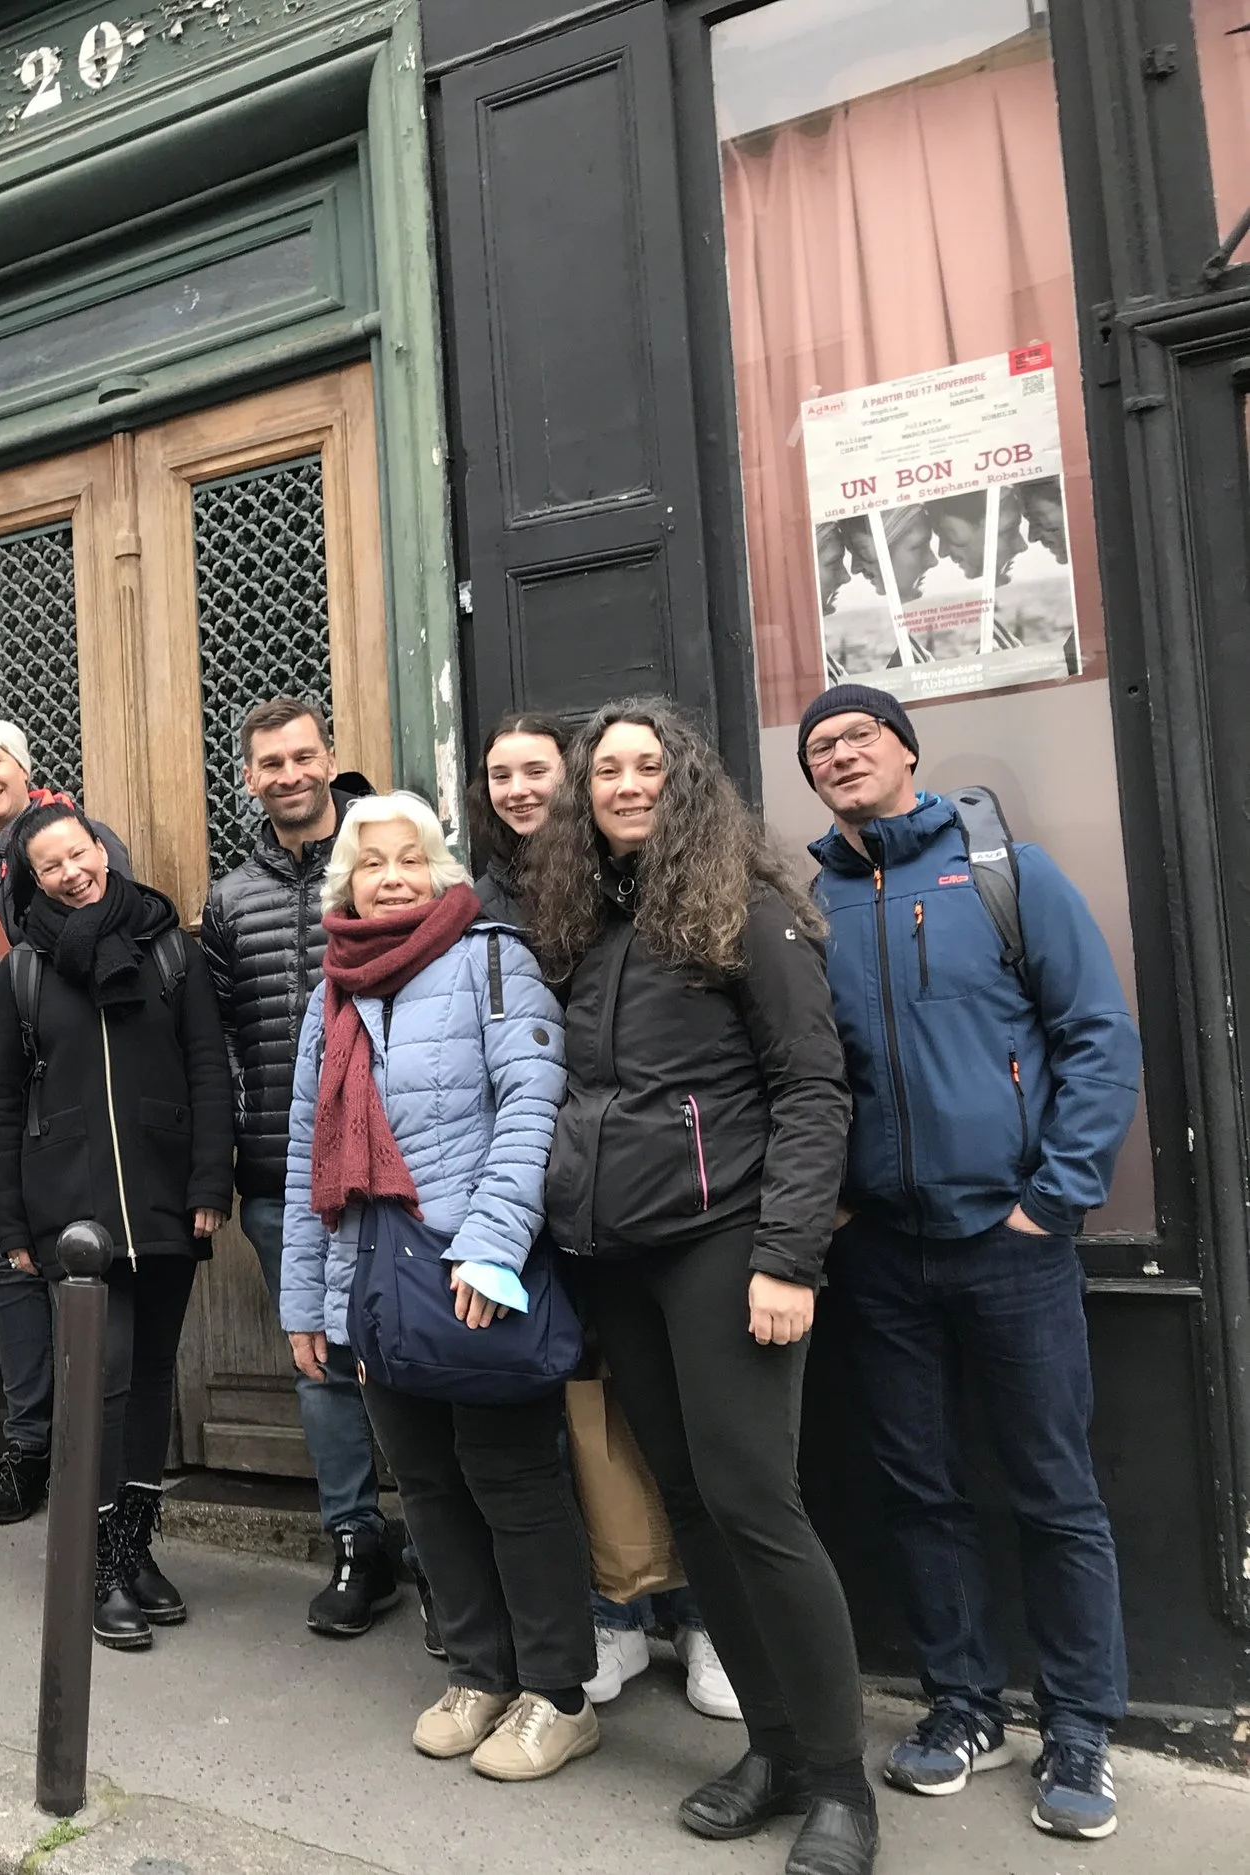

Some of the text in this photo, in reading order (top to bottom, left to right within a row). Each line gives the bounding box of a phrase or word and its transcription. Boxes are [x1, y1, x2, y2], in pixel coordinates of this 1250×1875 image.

[18, 21, 124, 119] 20
[870, 391, 903, 408] PARTIR
[905, 387, 919, 399] DU
[921, 385, 932, 396] 17
[934, 372, 987, 393] NOVEMBRE
[824, 507, 846, 518] une
[896, 491, 911, 503] de
[918, 477, 980, 499] Stéphane
[987, 464, 1043, 485] Robelin
[841, 443, 1033, 499] UN BON JOB
[911, 663, 983, 681] Manufacture
